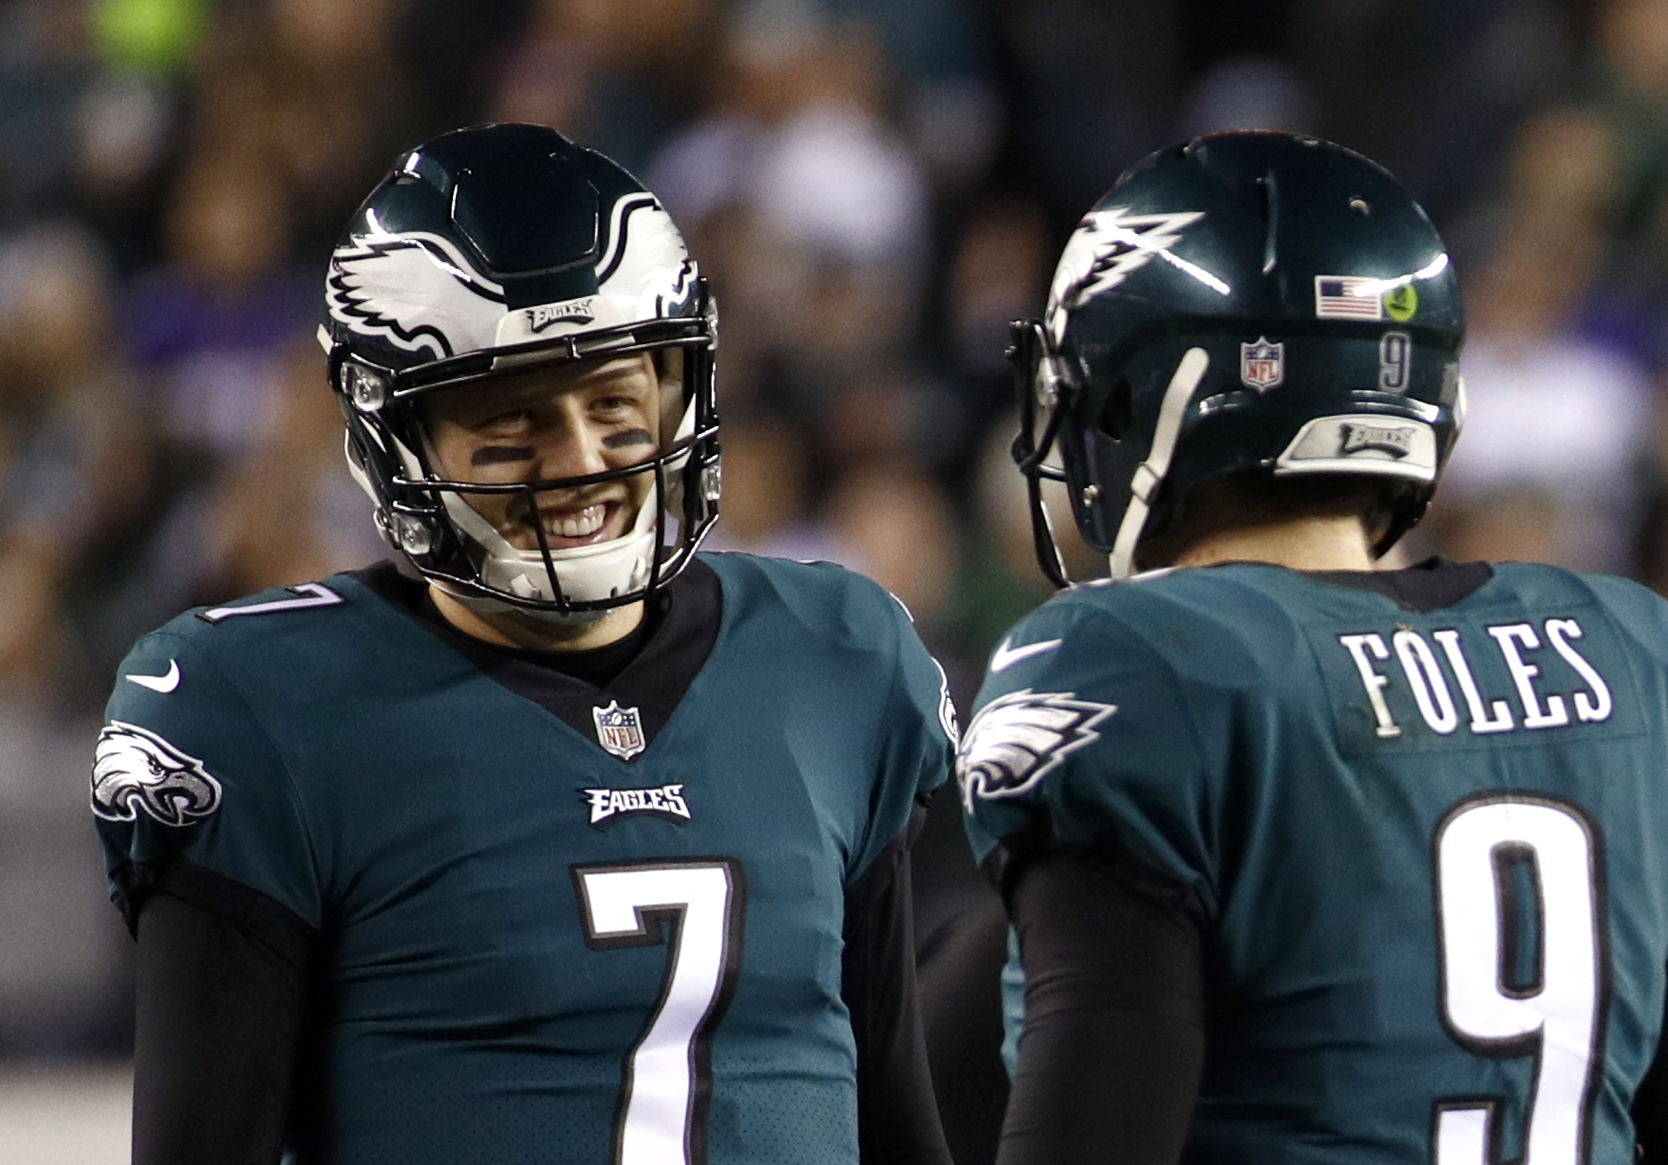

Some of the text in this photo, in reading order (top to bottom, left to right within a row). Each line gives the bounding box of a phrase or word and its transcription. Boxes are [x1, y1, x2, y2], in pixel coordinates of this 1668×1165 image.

[1248, 360, 1279, 382] NFL
[1379, 332, 1411, 393] 9
[199, 582, 345, 622] 7
[1340, 618, 1612, 737] FOLES
[604, 727, 639, 749] NFL
[584, 784, 692, 824] EAGLES
